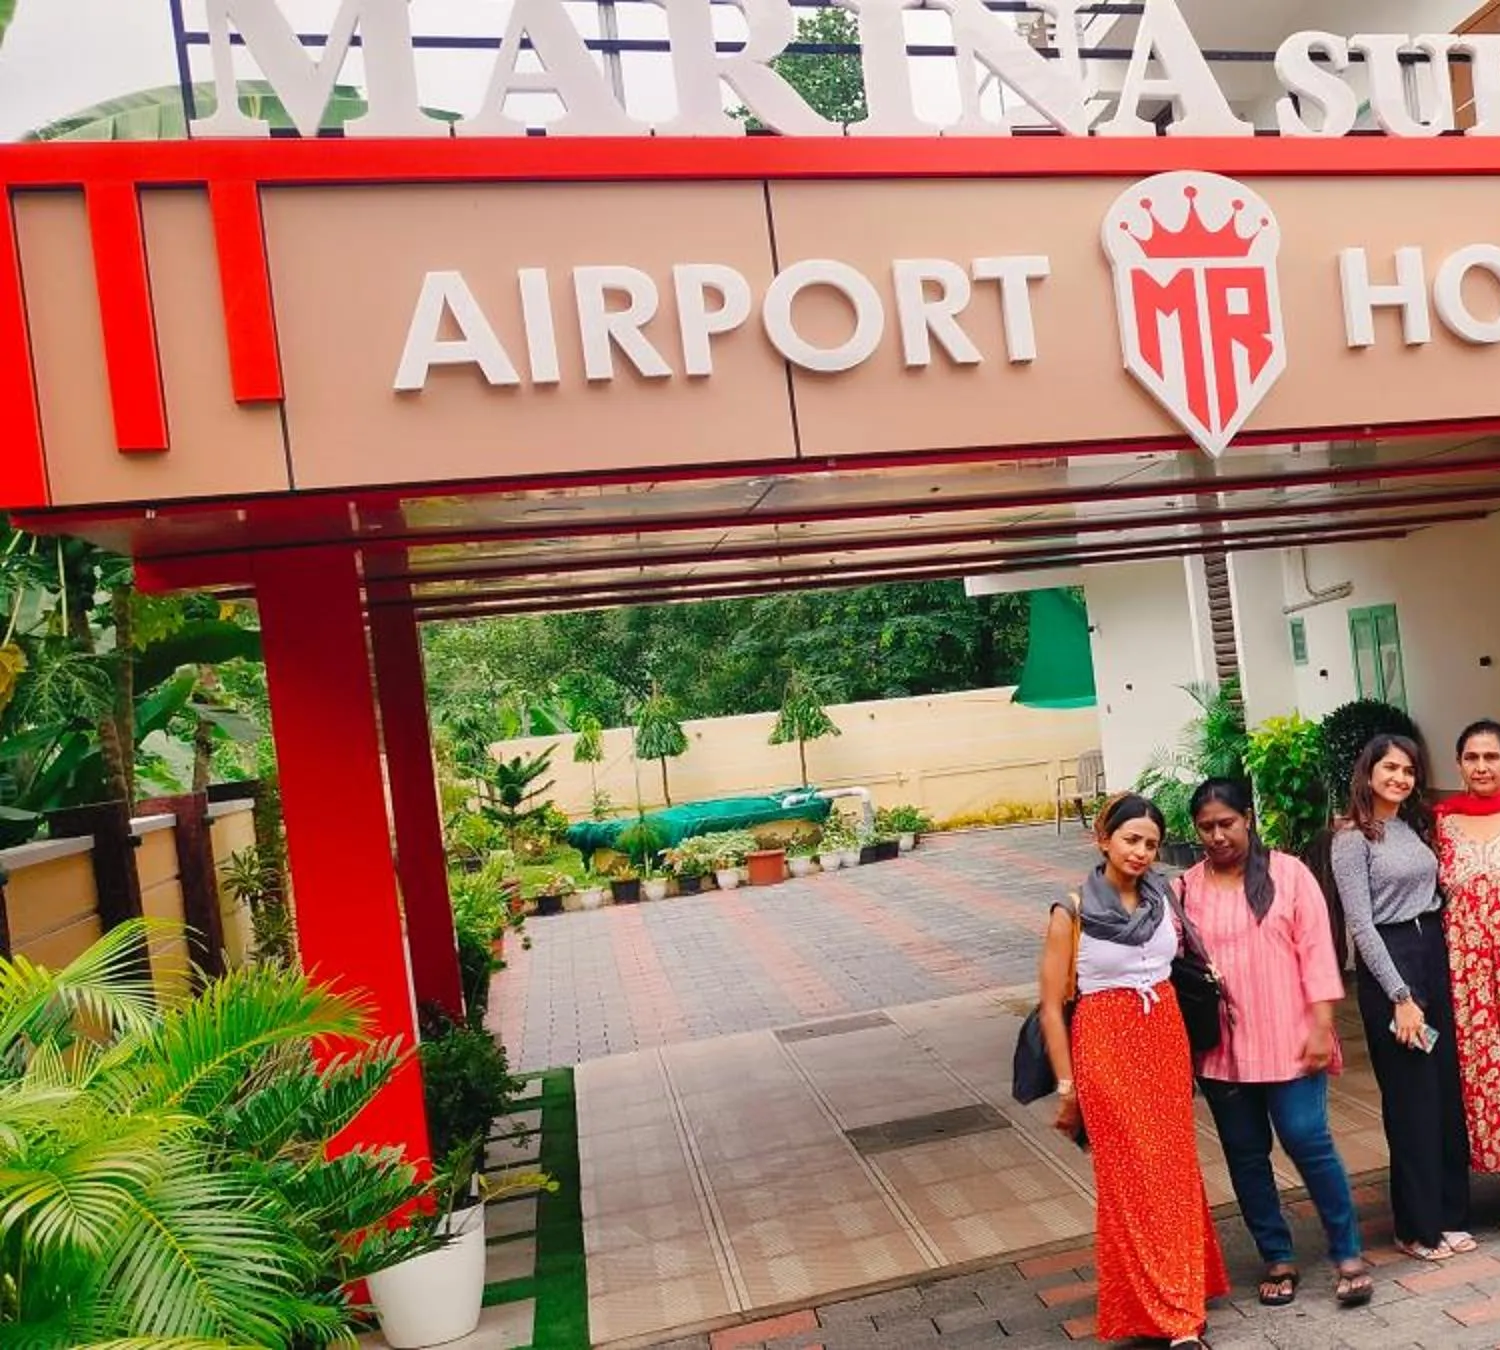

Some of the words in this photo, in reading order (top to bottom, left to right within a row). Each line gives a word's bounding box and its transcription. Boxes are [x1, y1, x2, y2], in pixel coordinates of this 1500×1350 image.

[190, 0, 1254, 138] MARINA
[393, 254, 1052, 394] AIRPORT
[1130, 266, 1276, 437] MR
